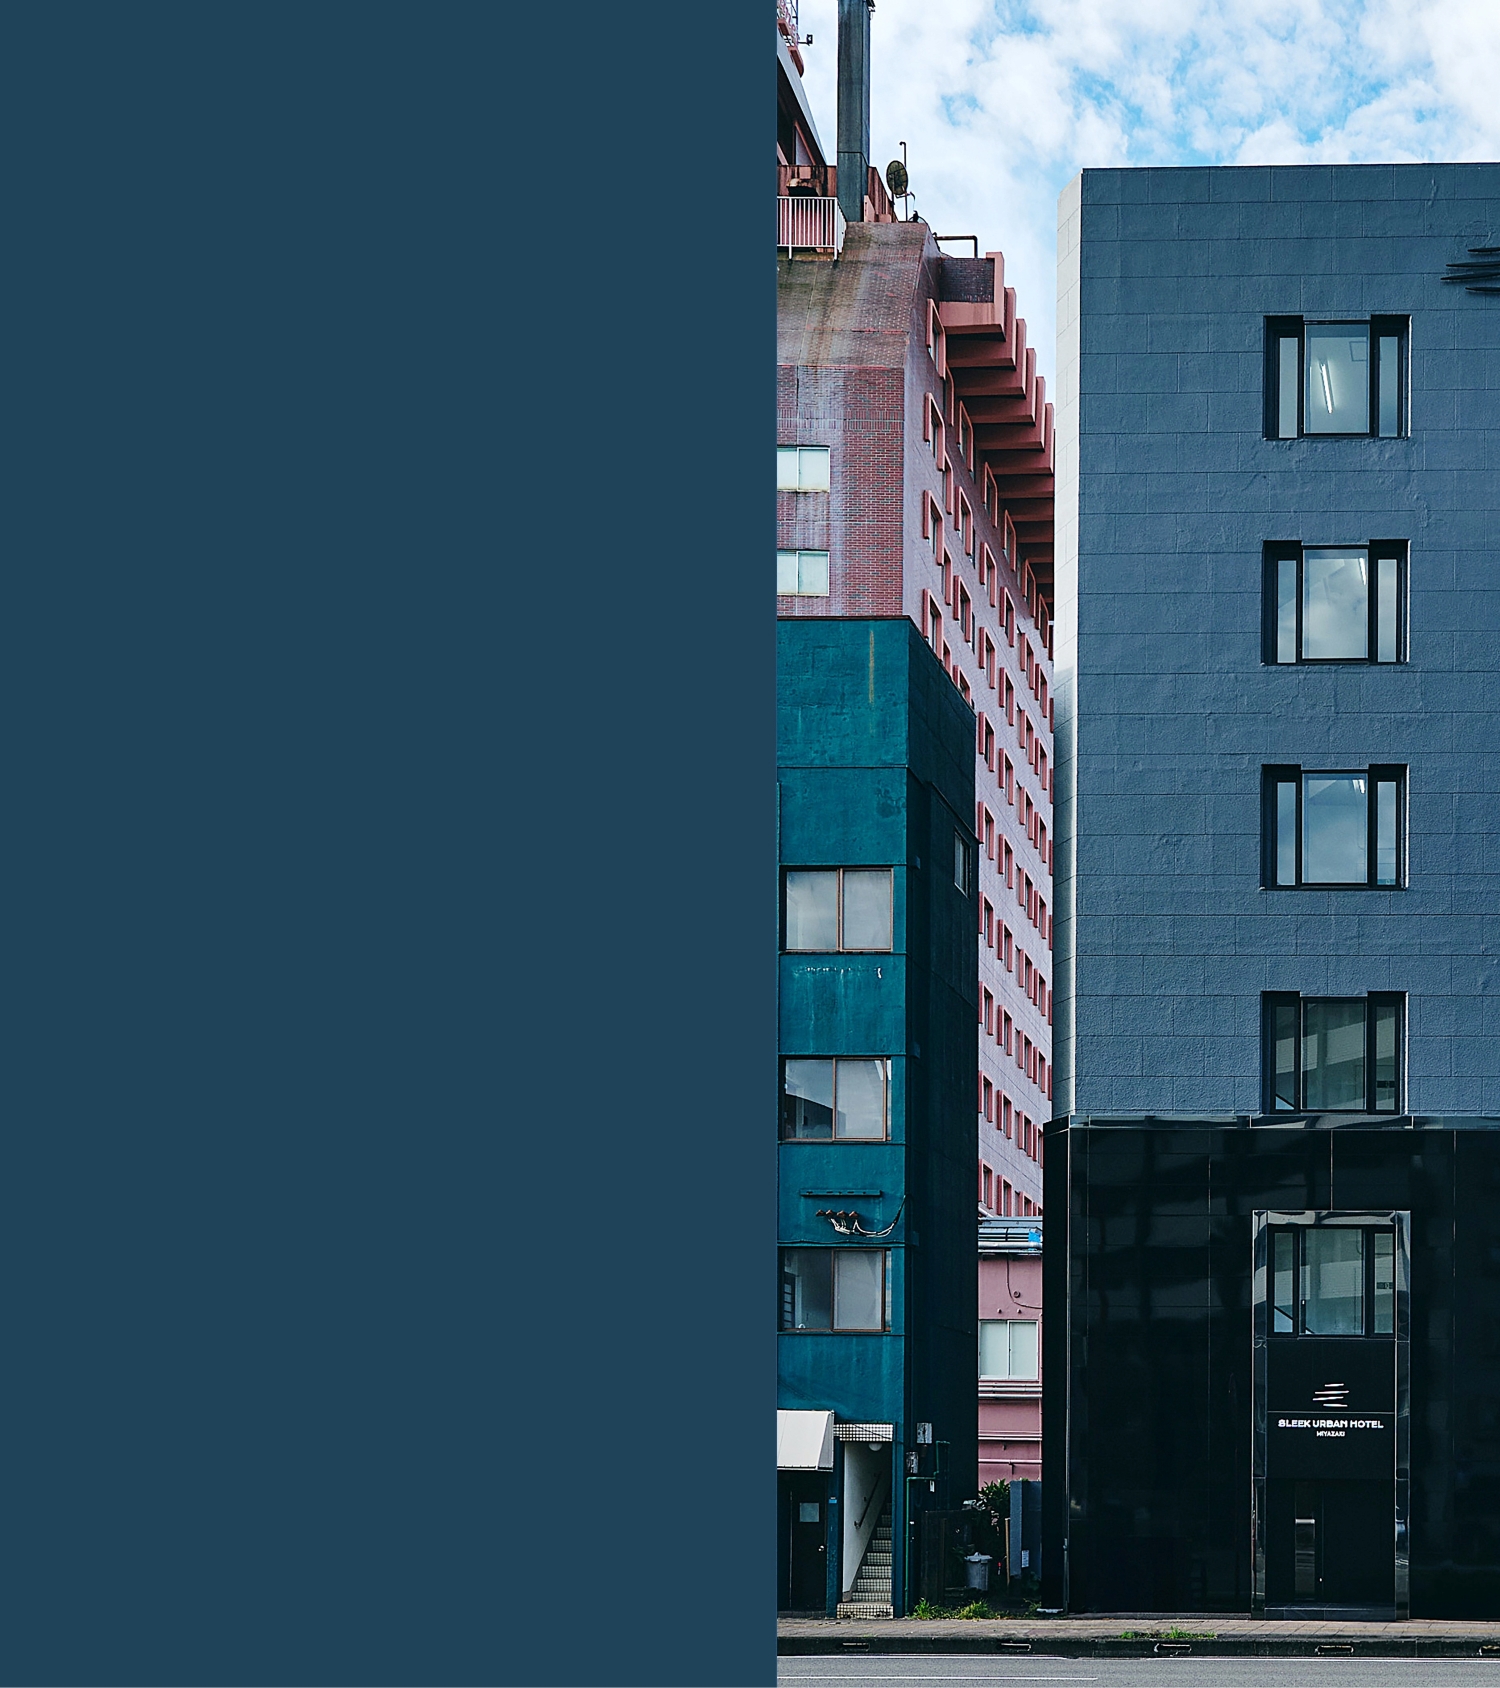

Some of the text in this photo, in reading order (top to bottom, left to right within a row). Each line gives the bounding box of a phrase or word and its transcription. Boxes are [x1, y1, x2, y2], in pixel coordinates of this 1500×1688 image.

[1278, 1419, 1384, 1429] SLEEK URBAN HOTEL
